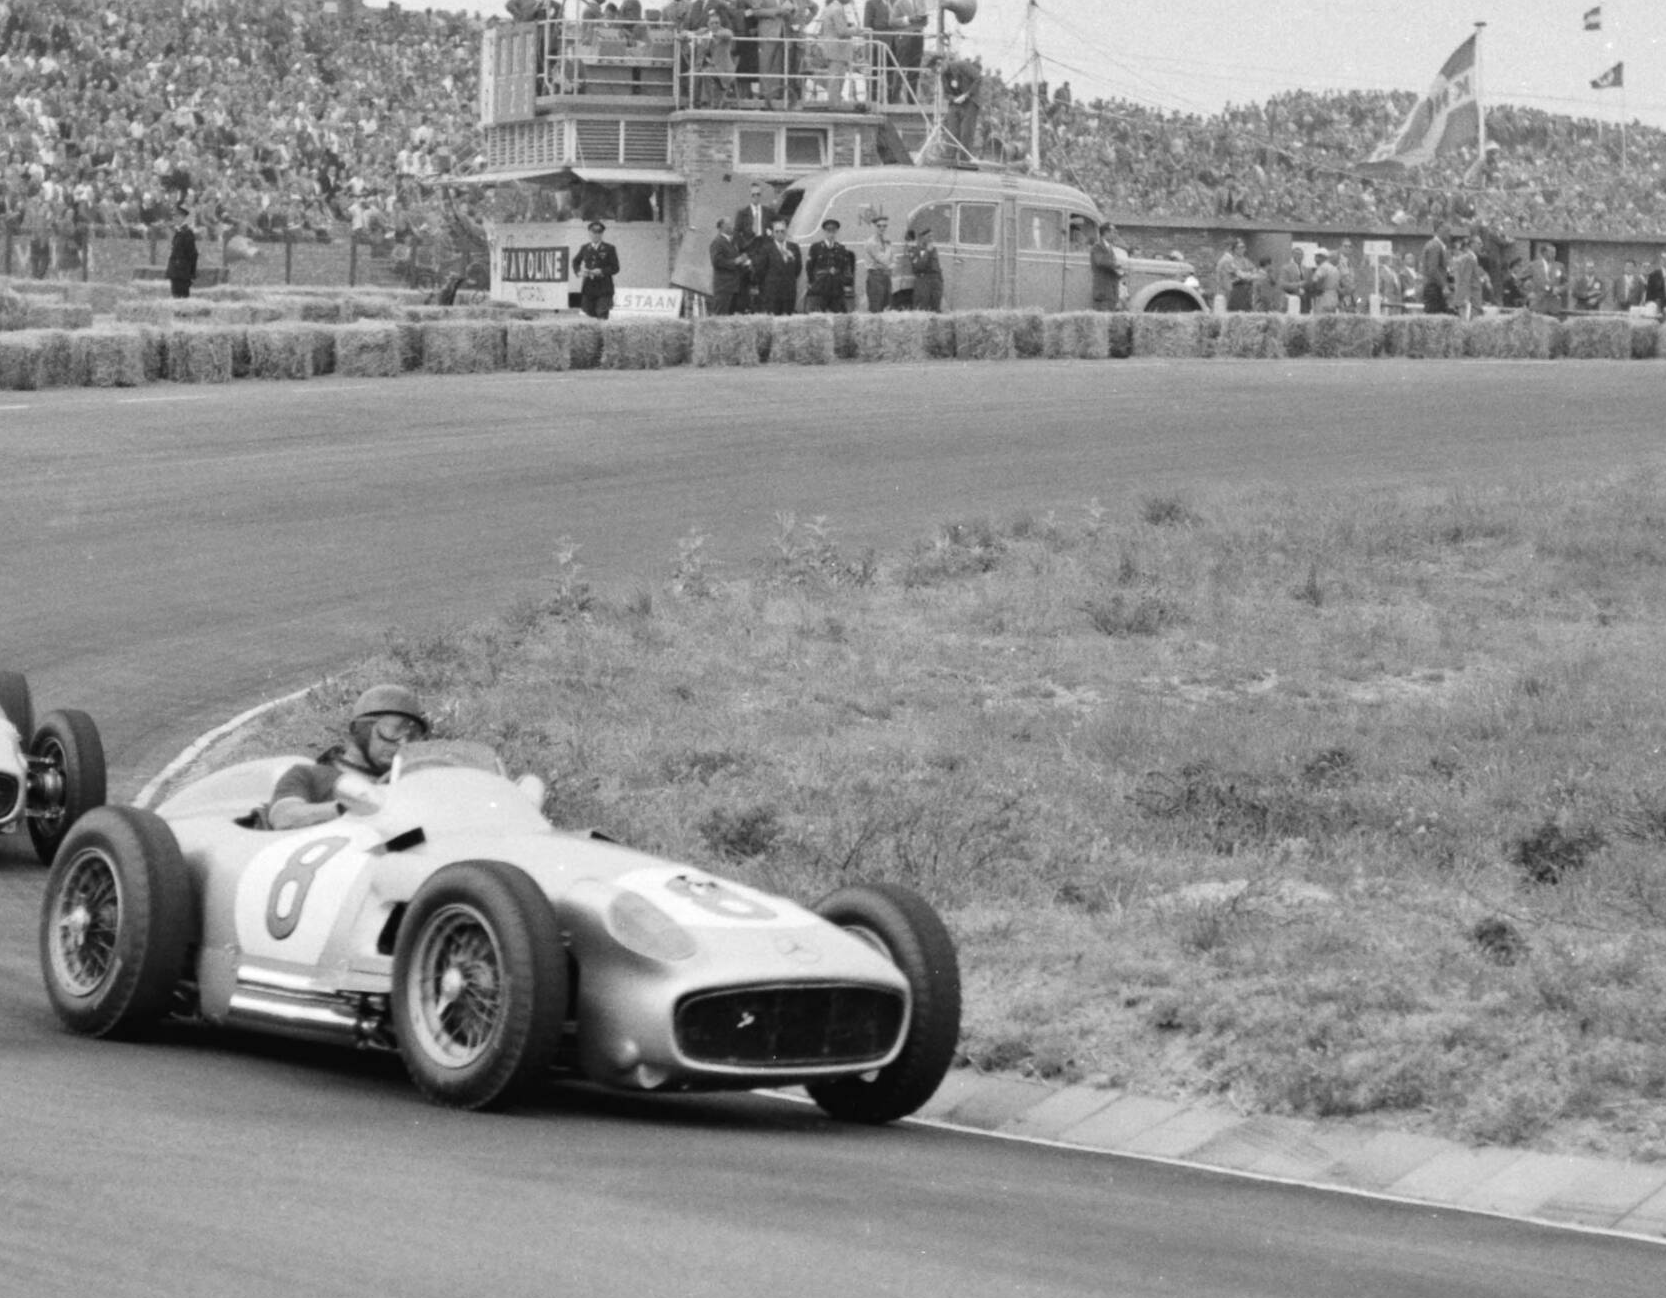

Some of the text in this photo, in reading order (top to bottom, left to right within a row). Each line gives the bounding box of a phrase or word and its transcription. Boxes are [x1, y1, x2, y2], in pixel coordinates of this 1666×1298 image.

[502, 250, 562, 281] HAVOLINE
[265, 835, 351, 941] 8
[663, 874, 779, 921] 8
